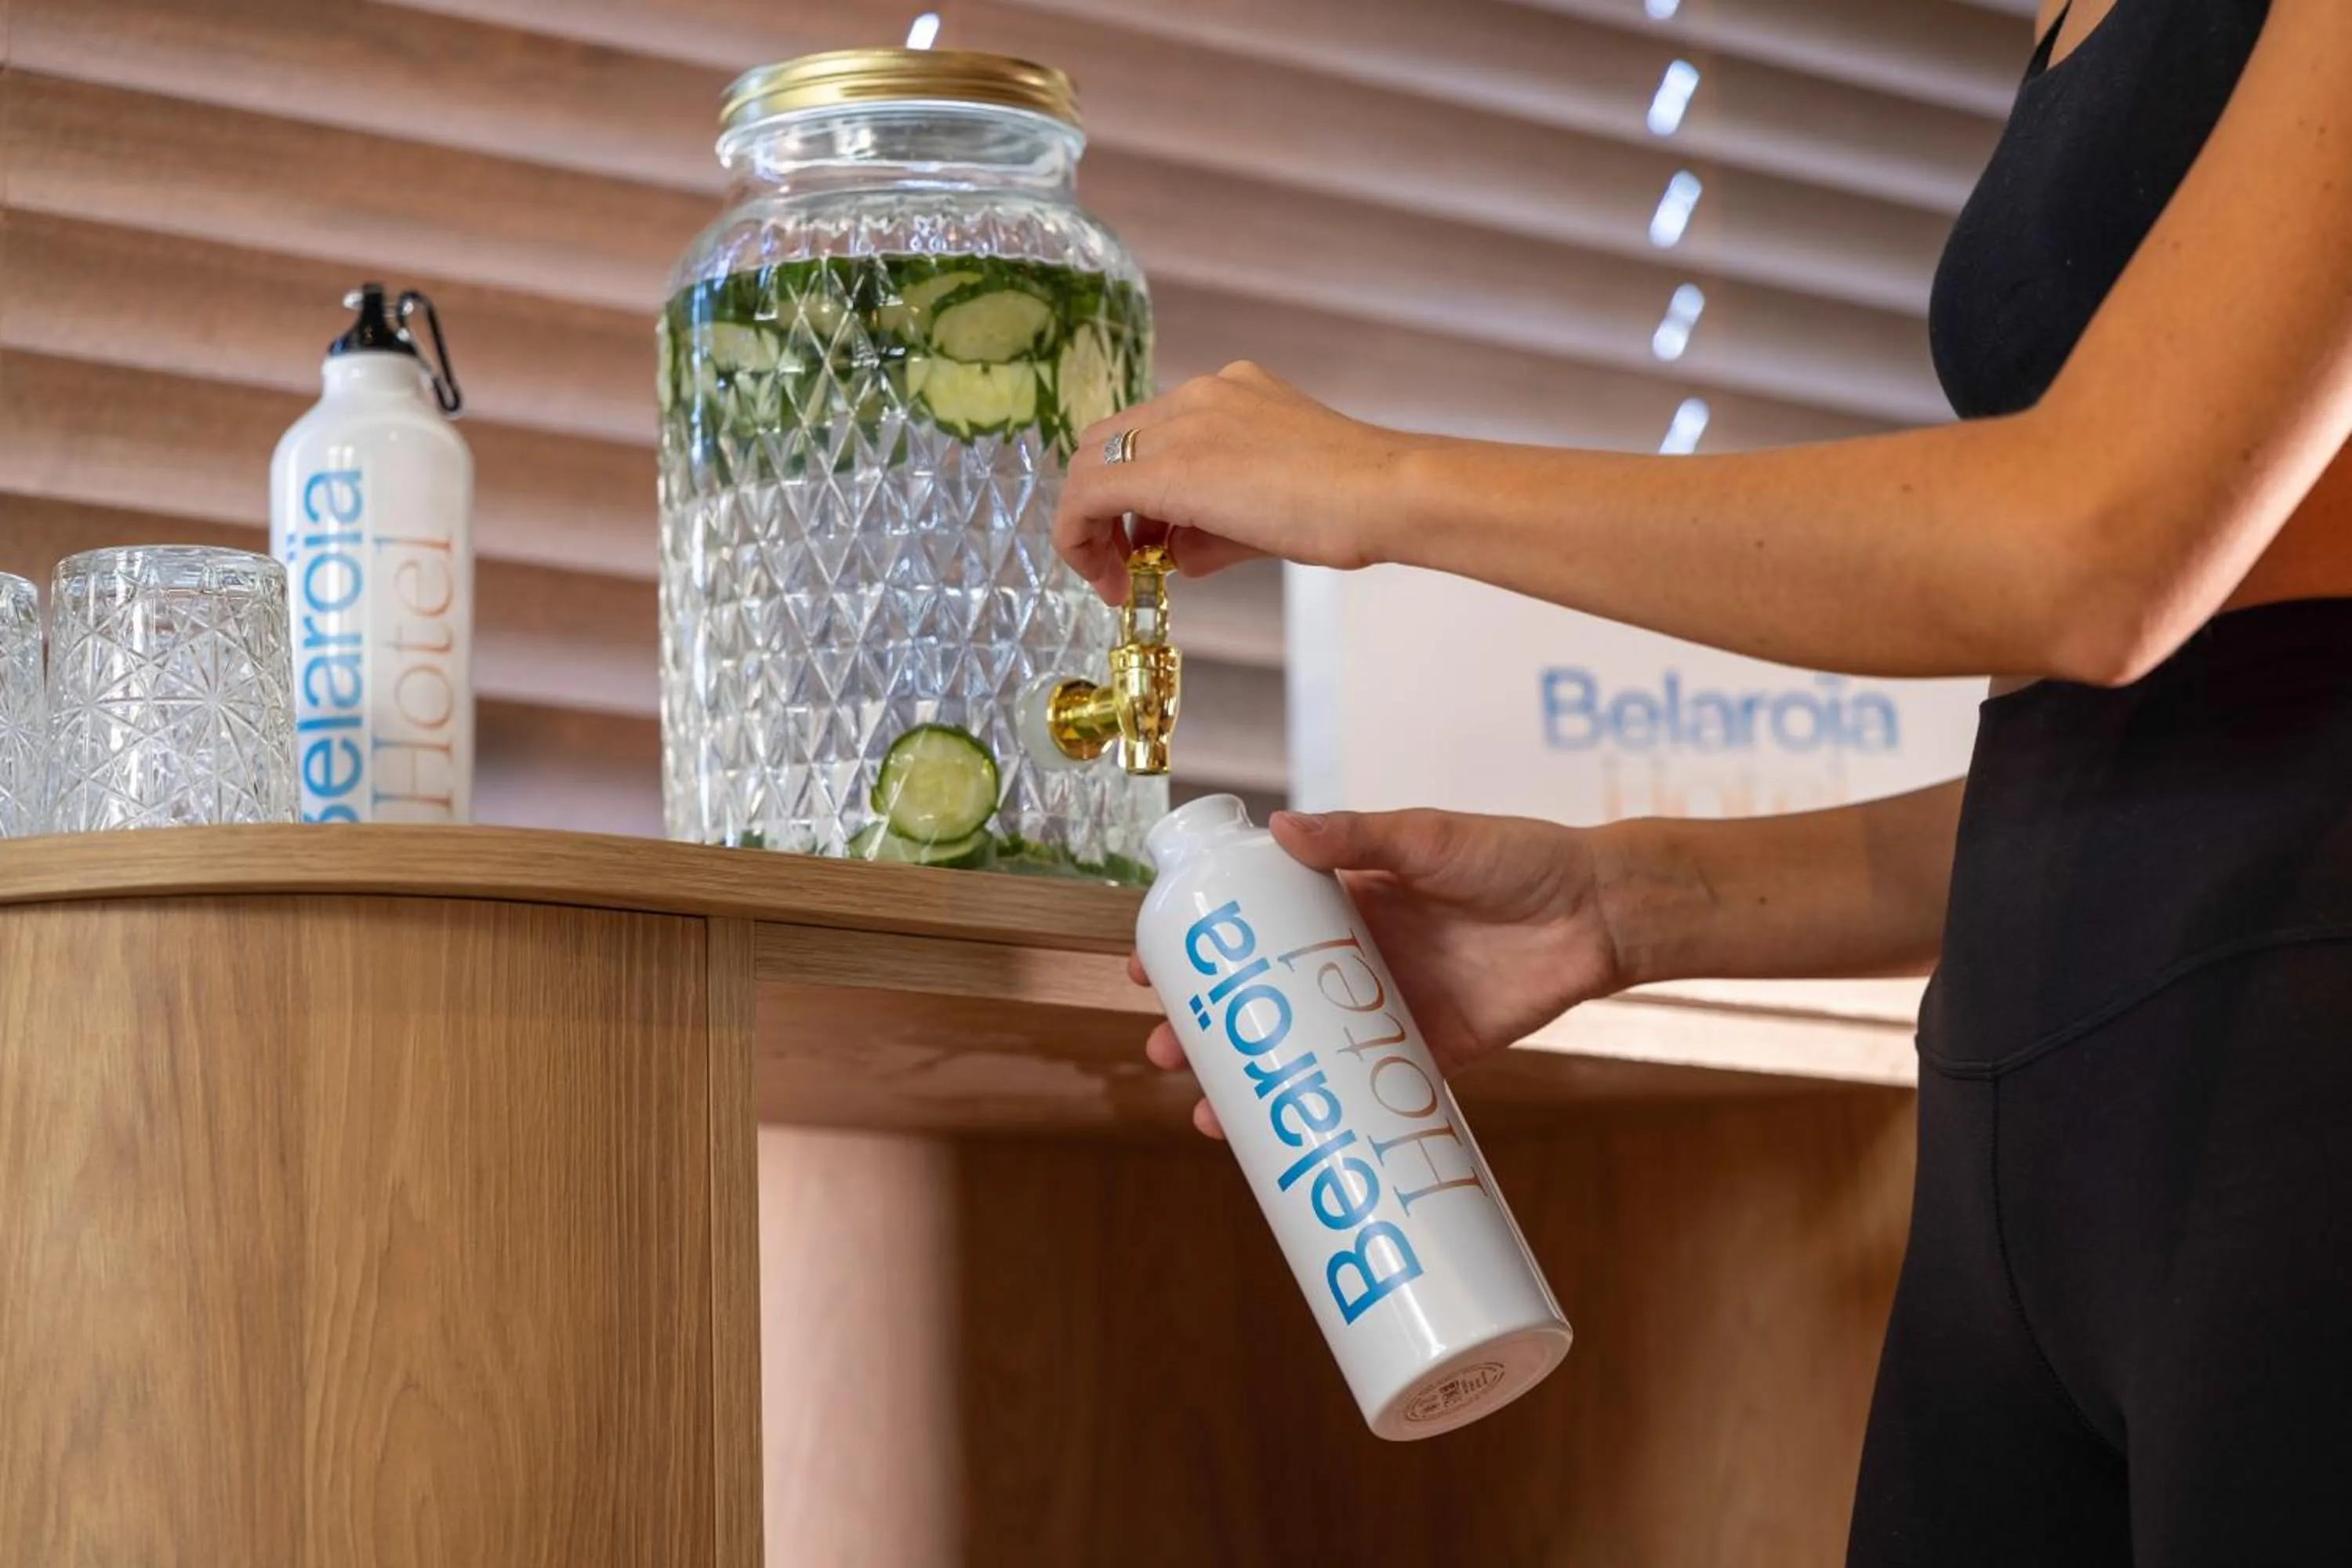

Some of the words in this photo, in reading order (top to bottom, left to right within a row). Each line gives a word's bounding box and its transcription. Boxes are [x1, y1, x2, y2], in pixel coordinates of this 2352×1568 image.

[372, 532, 455, 816] Hotel
[1184, 900, 1425, 1326] Belaroïa
[1278, 927, 1488, 1218] Hotel
